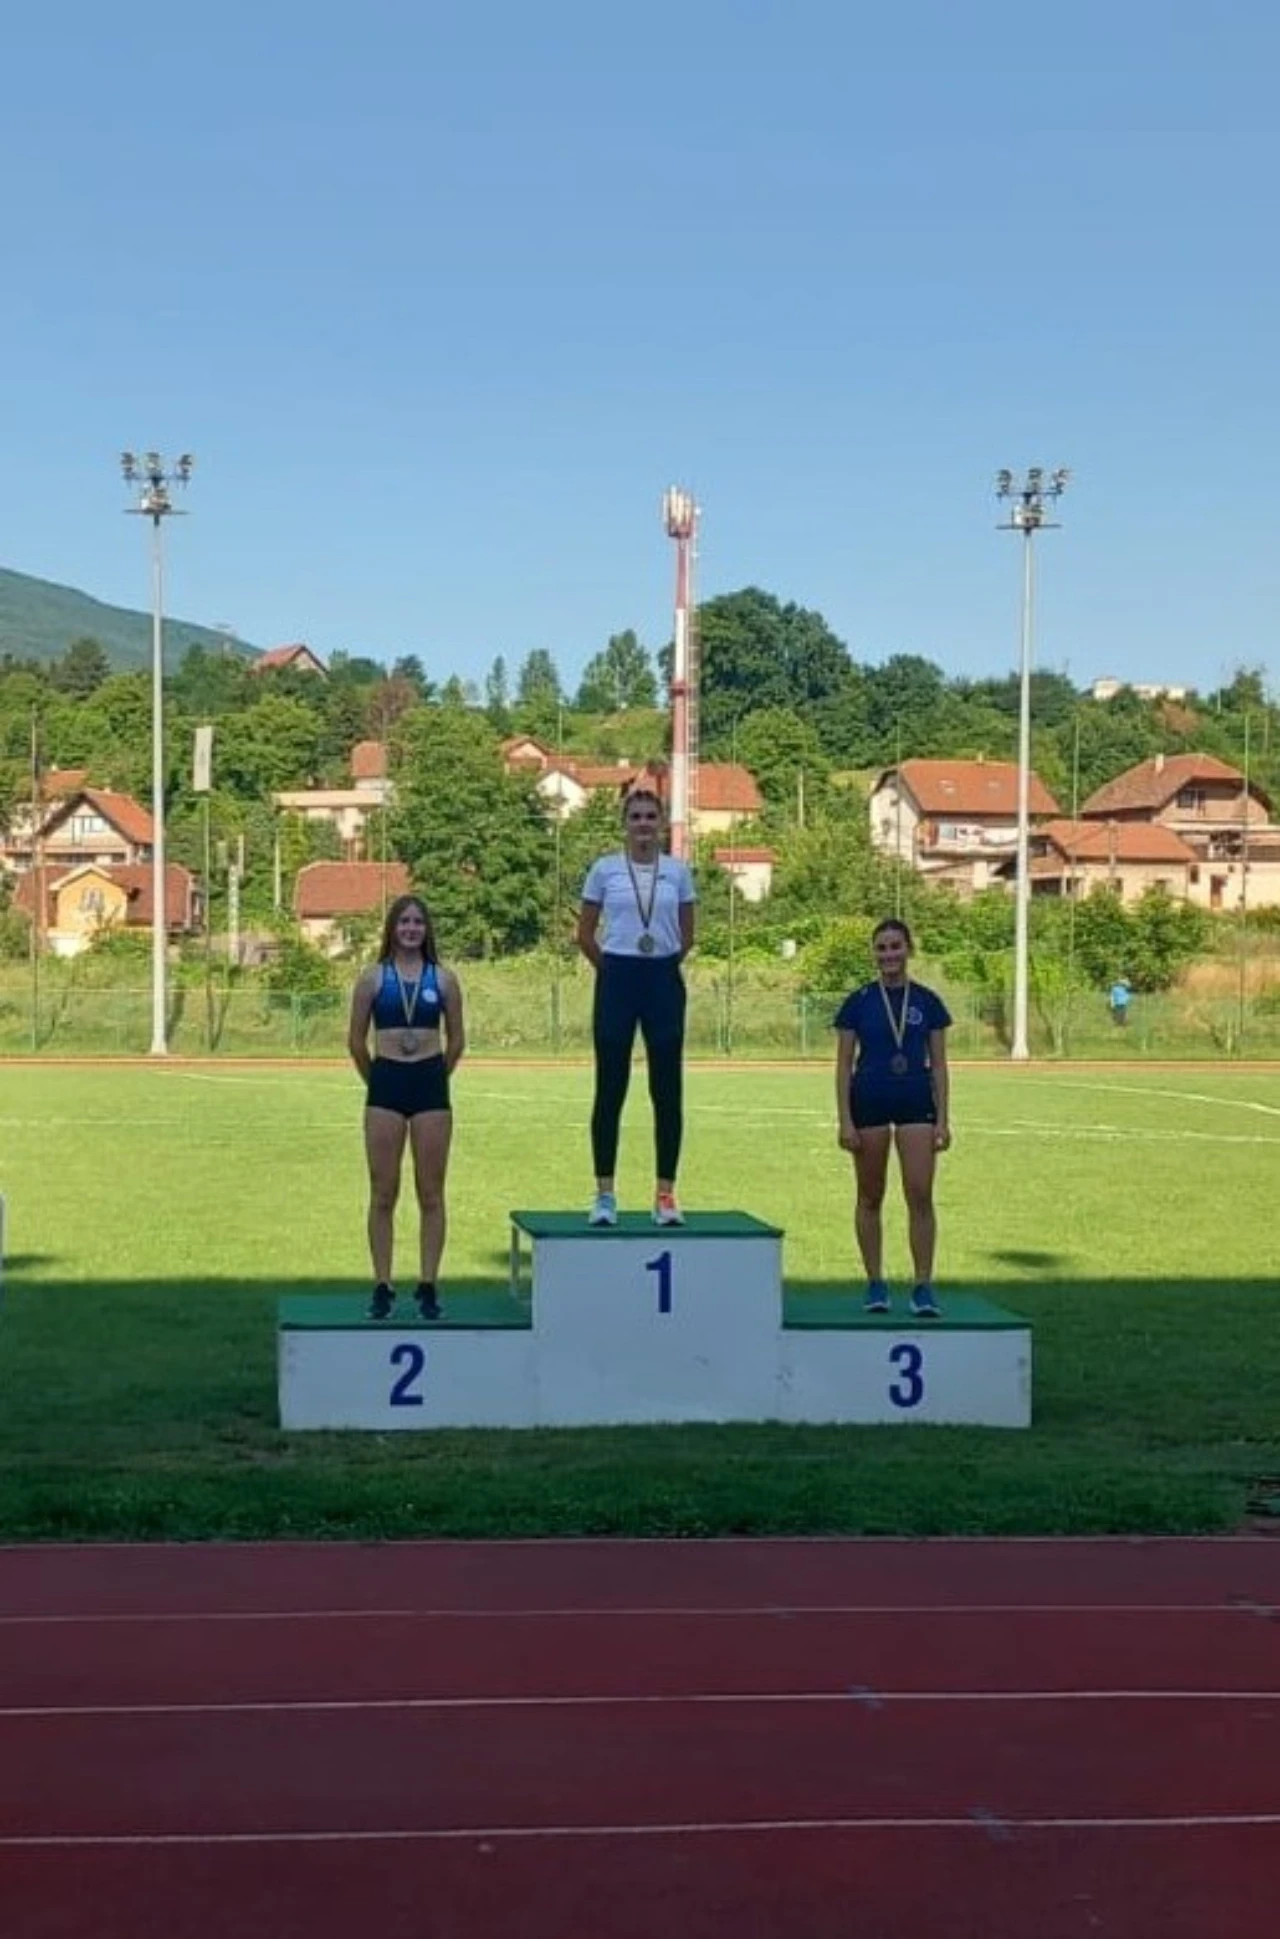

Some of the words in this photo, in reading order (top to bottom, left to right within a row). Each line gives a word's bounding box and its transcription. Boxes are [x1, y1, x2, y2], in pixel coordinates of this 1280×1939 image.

[645, 1251, 672, 1313] 1
[389, 1344, 425, 1406] 2
[888, 1344, 924, 1407] 3
